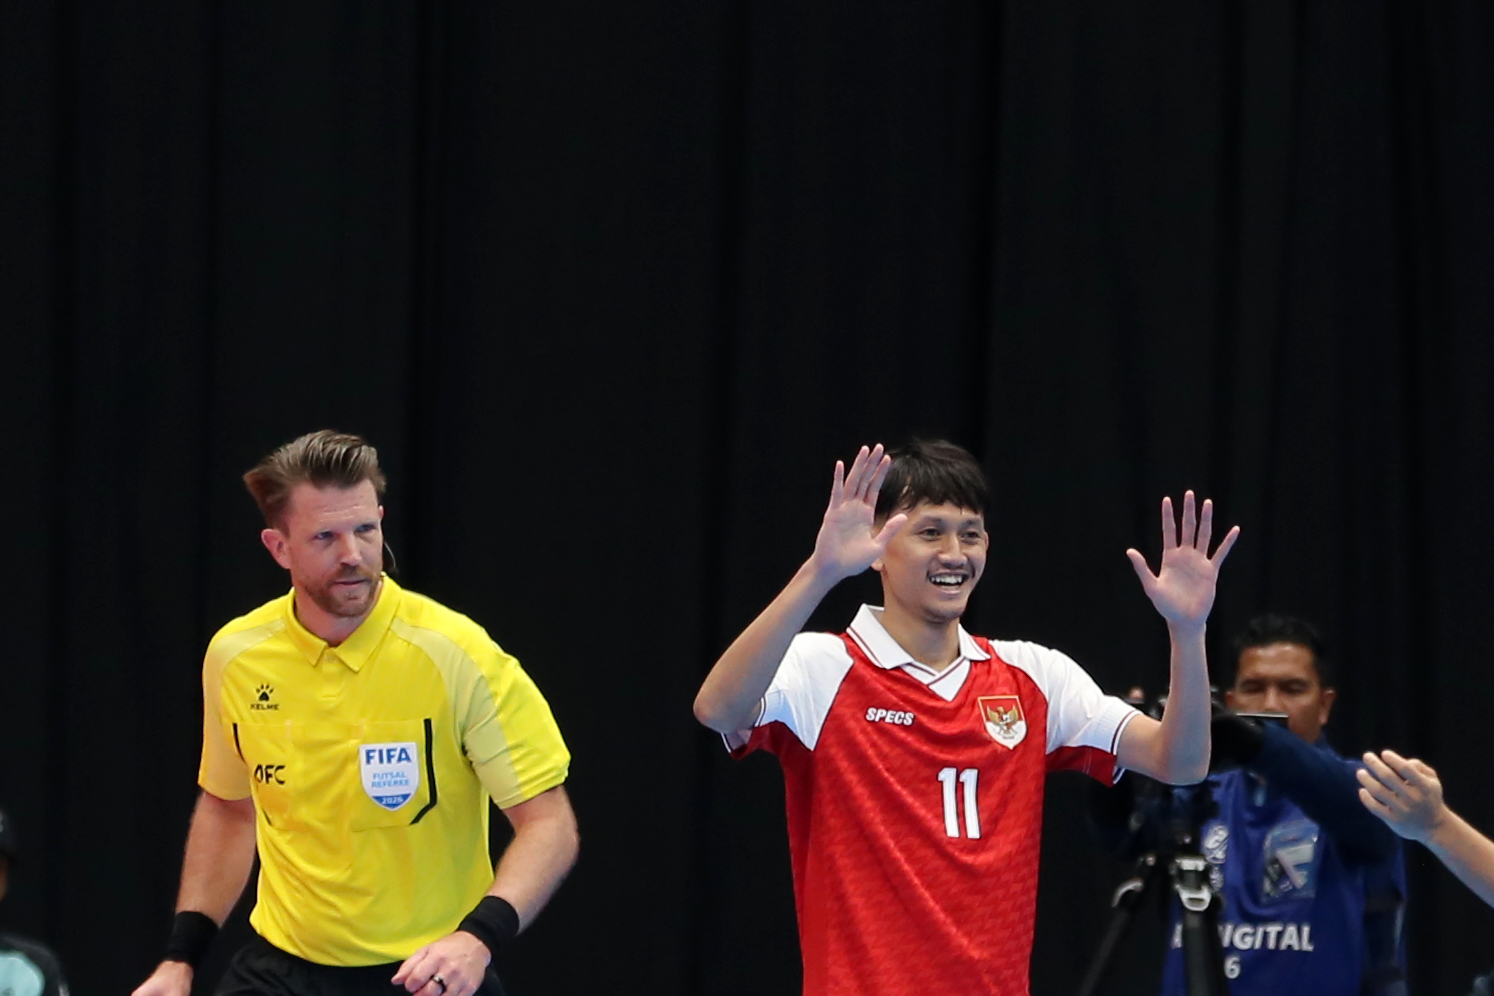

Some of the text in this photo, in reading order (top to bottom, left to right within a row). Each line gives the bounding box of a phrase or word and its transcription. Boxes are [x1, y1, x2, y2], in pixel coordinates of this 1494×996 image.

[866, 707, 915, 726] SPECS
[365, 747, 412, 765] FIFA
[371, 779, 409, 788] REFEREE
[373, 772, 406, 780] FUTSAL
[937, 767, 981, 839] 11
